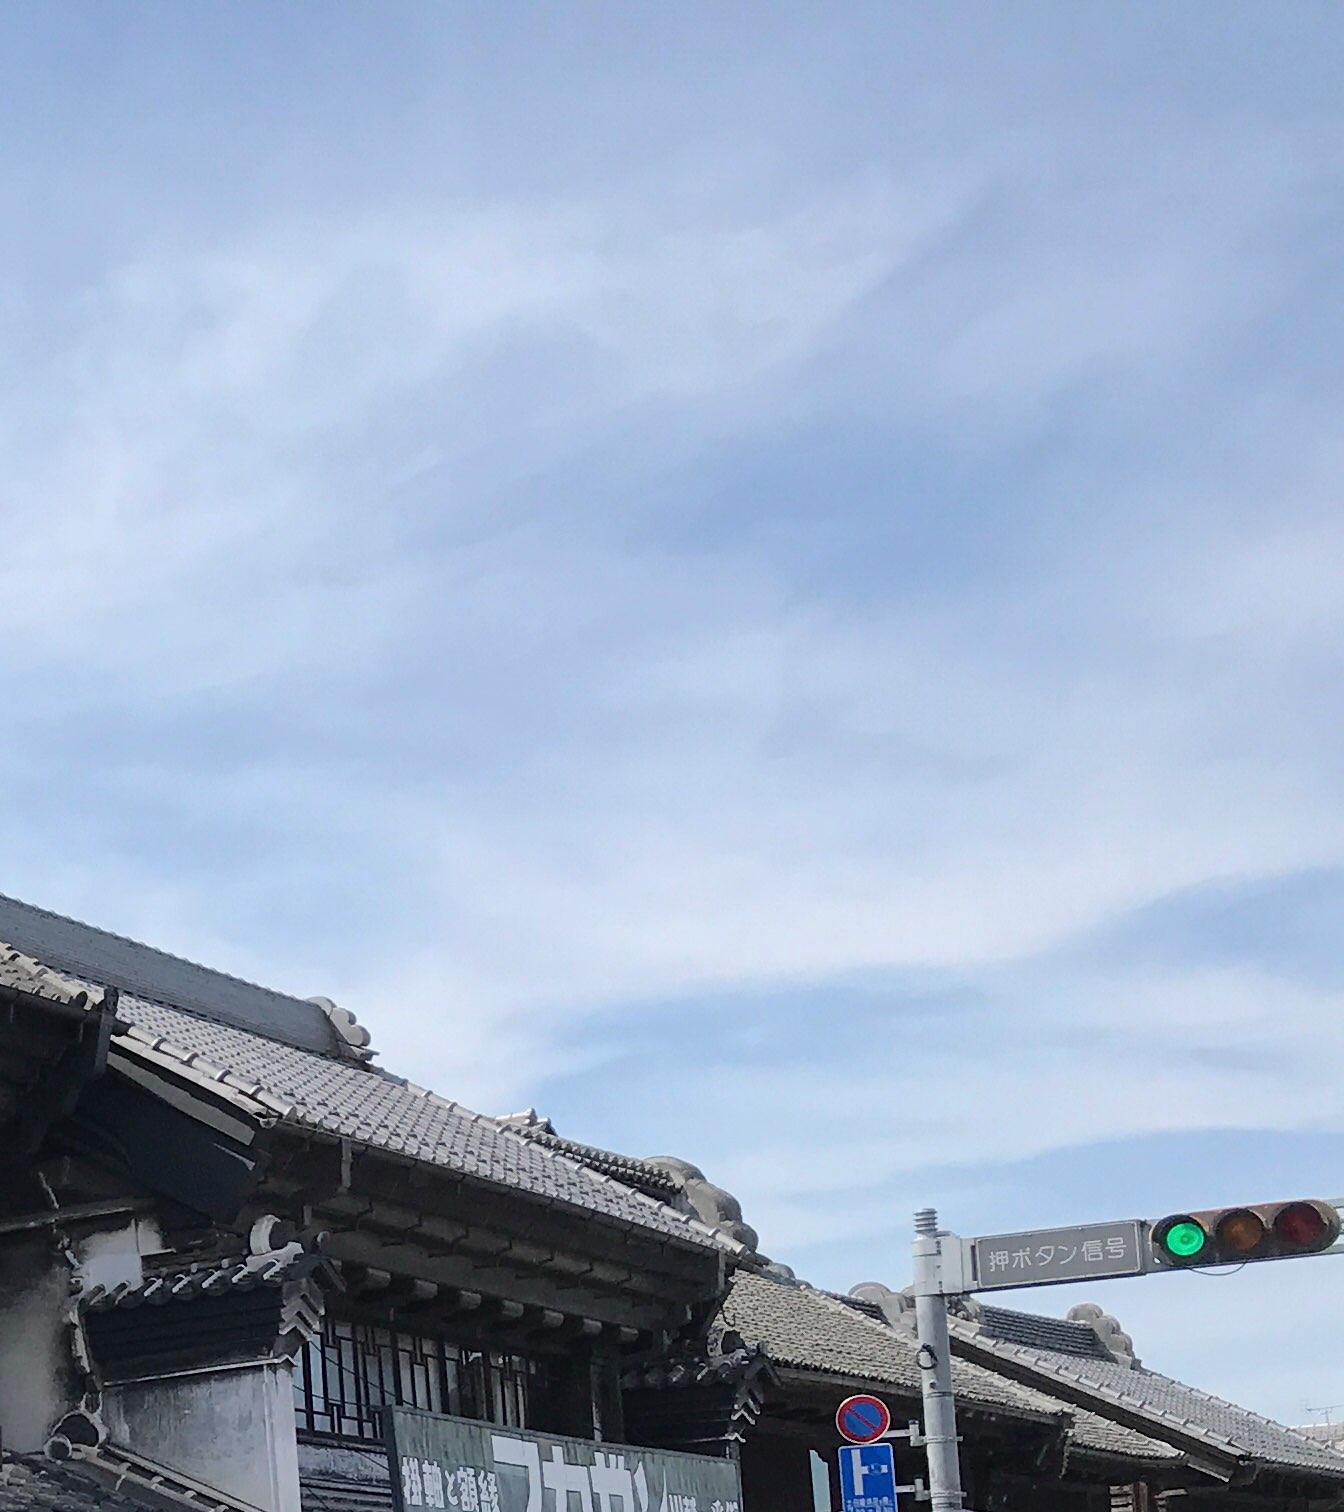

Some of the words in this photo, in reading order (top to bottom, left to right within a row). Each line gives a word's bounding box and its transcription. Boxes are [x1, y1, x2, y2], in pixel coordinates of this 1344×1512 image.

[989, 1236, 1127, 1272] 押ボタン信号
